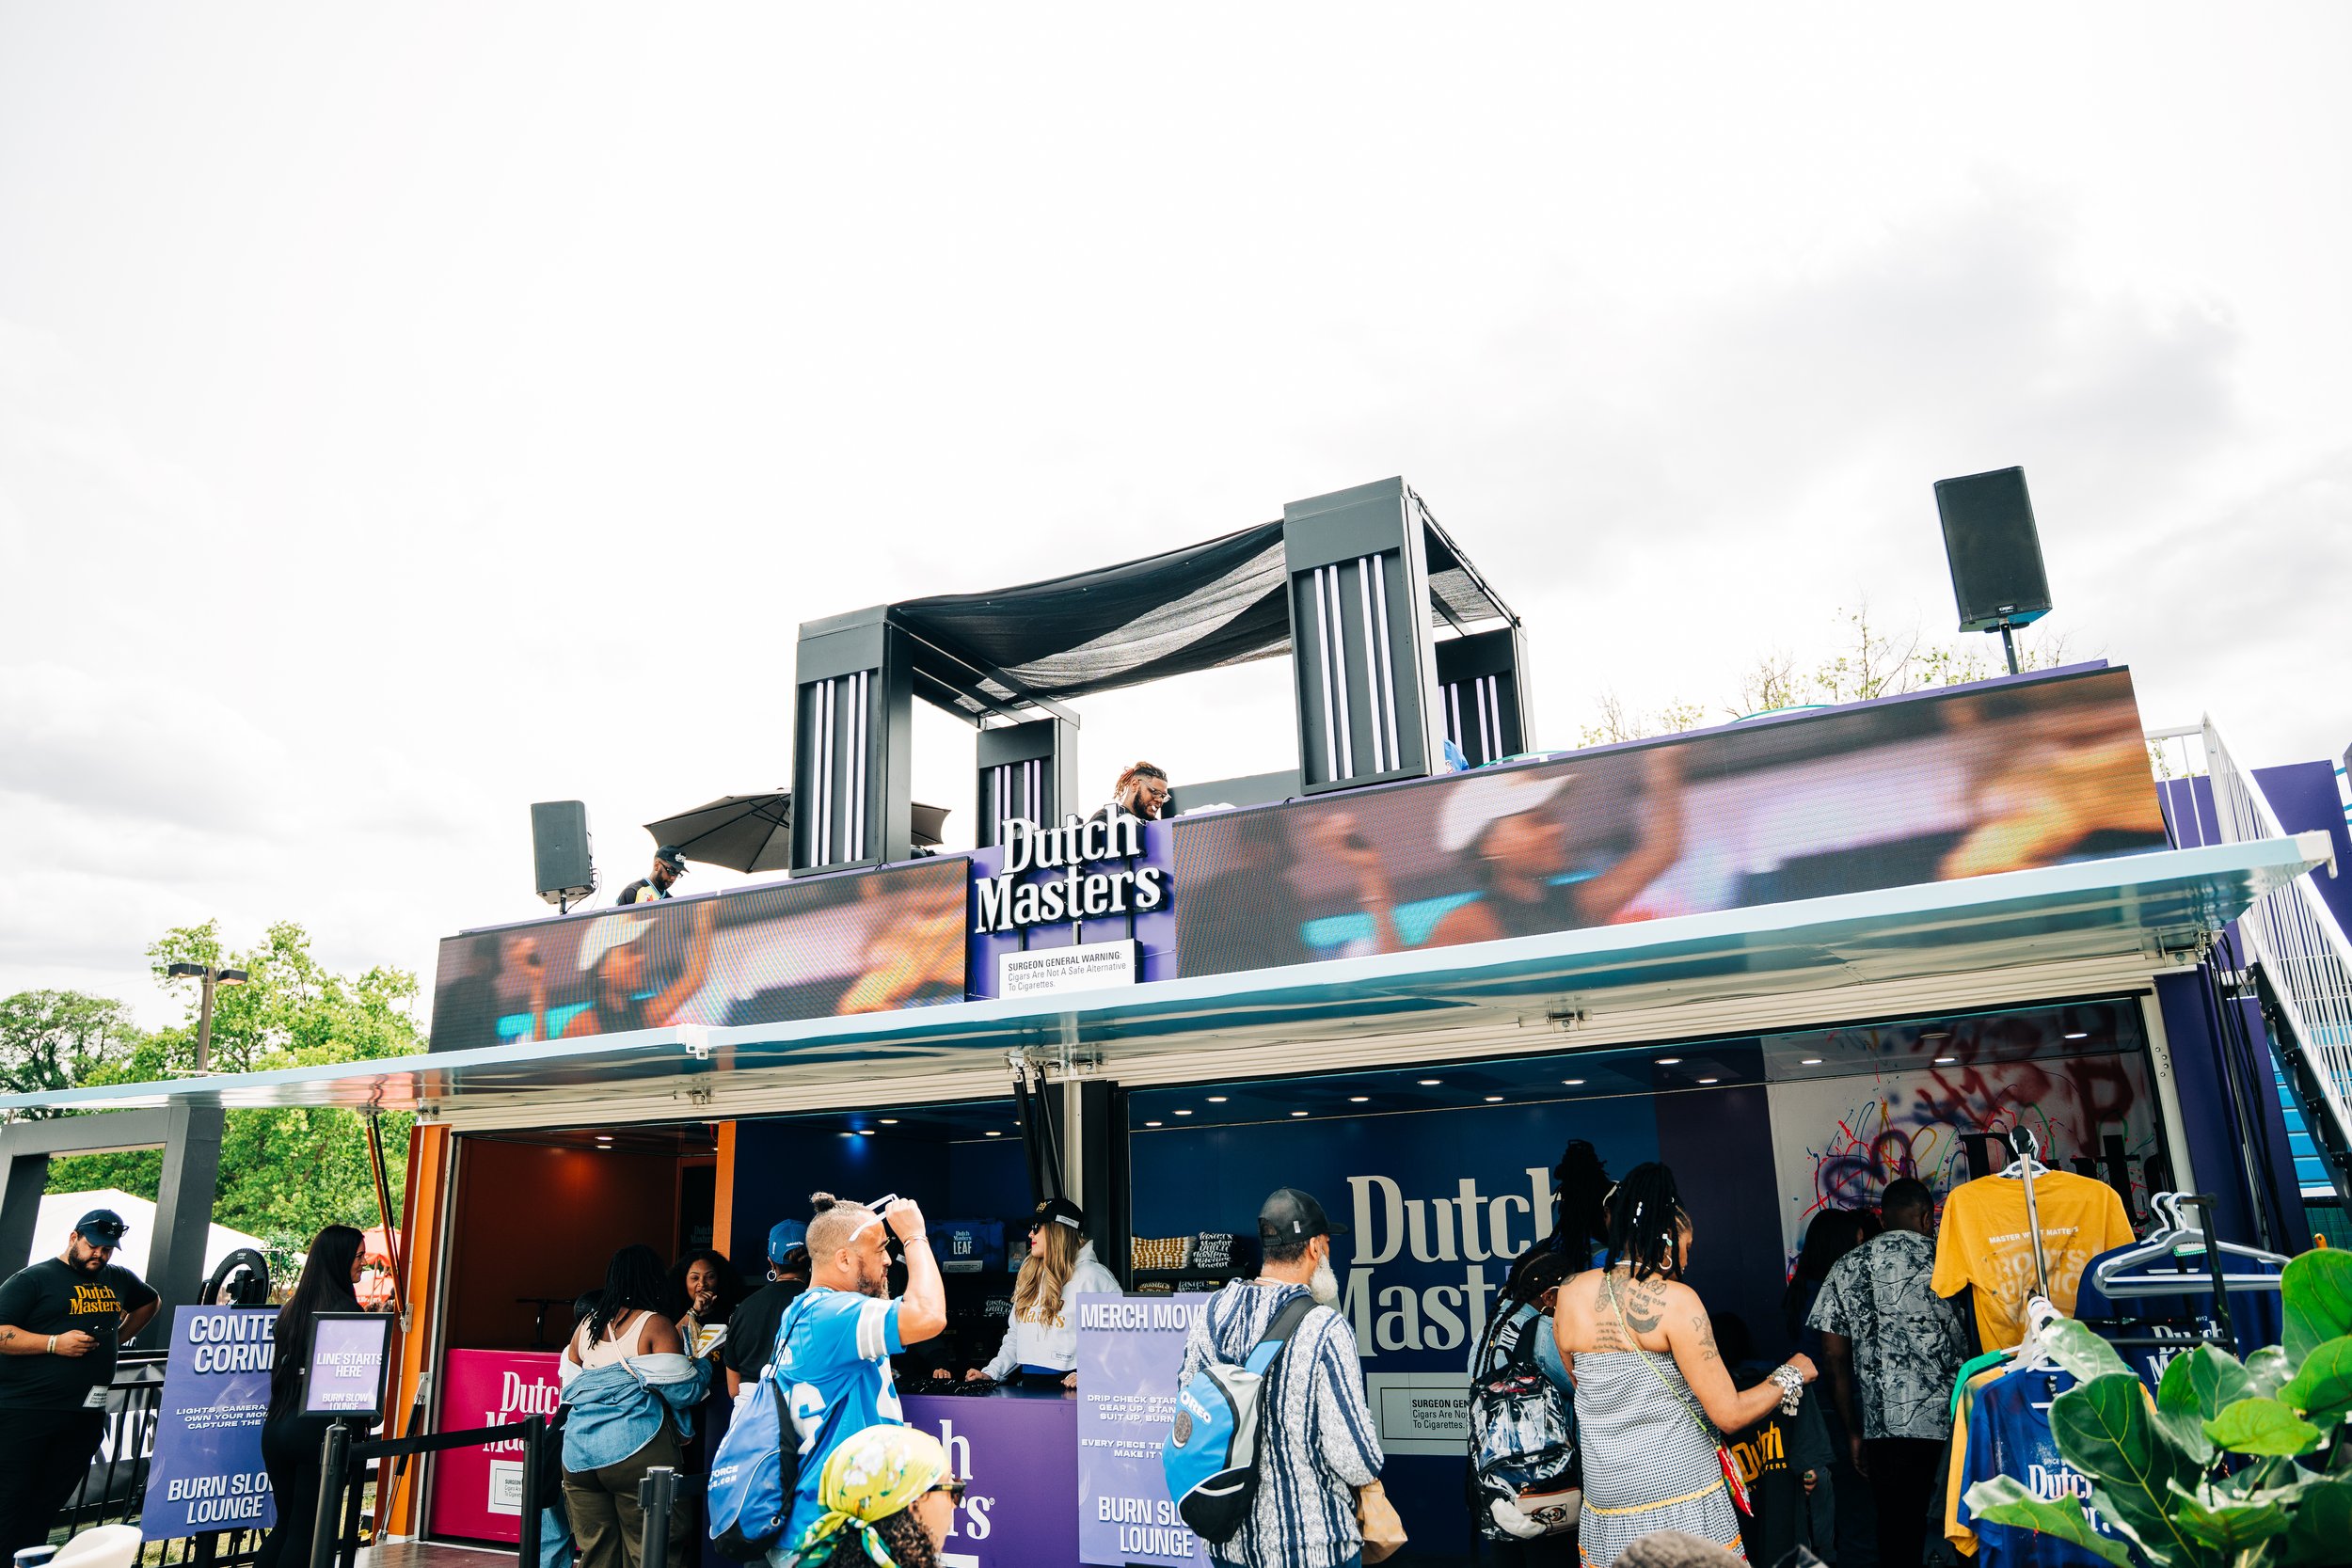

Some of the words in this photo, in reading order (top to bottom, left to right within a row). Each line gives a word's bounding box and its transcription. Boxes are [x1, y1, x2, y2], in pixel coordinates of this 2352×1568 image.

[1001, 803, 1140, 875] Dutch
[975, 866, 1161, 934] Masters
[1008, 959, 1044, 972] SURGEON
[1045, 956, 1080, 967] GENERAL
[1081, 950, 1122, 963] WARNING:
[1008, 973, 1031, 982] Cigars
[1032, 970, 1045, 979] Are
[1046, 968, 1059, 978] Not
[1068, 966, 1085, 975] Safe
[1086, 962, 1127, 974] Alternative
[1008, 983, 1017, 991] To
[1017, 980, 1057, 991] Cigarettes.
[1989, 1233, 2021, 1243] MASTER
[2022, 1229, 2044, 1238] WT
[953, 1242, 972, 1255] LEAF
[73, 1285, 117, 1299] Dutch
[69, 1298, 121, 1315] Masters
[1327, 1264, 1504, 1357] Mast
[1080, 1304, 1149, 1331] MERCH
[1153, 1304, 1204, 1331] MOV
[316, 1353, 342, 1366] LINE
[342, 1353, 383, 1366] STARTS
[335, 1365, 363, 1378] HERE
[322, 1392, 345, 1402] BURN
[345, 1392, 370, 1402] SLOW
[500, 1370, 562, 1415] Dutc
[1087, 1394, 1111, 1402] DRIP
[1113, 1395, 1147, 1403] CHECK
[176, 1407, 219, 1416] LIGHTS,
[222, 1403, 268, 1413] CAMERA,
[329, 1402, 359, 1411] LOUNGE
[1099, 1404, 1127, 1413] GEAR
[1129, 1405, 1146, 1415] UP,
[1180, 1390, 1213, 1424] OREO
[1412, 1399, 1451, 1408] SURGEON
[1100, 1413, 1124, 1421] SUIT
[1125, 1414, 1143, 1423] UP,
[1412, 1409, 1437, 1419] Cigars
[1438, 1410, 1452, 1418] Are
[188, 1421, 238, 1430] CAPTURE
[1423, 1420, 1465, 1430] Cigarettes.
[1081, 1439, 1114, 1448] EVERY
[1114, 1449, 1143, 1459] MAKE
[167, 1475, 228, 1501] BURN
[230, 1471, 273, 1497] SLO
[186, 1495, 264, 1525] LOUNGE
[1098, 1496, 1152, 1525] BURN
[1156, 1499, 1189, 1527] SL
[1120, 1526, 1194, 1558] LOUNGE
